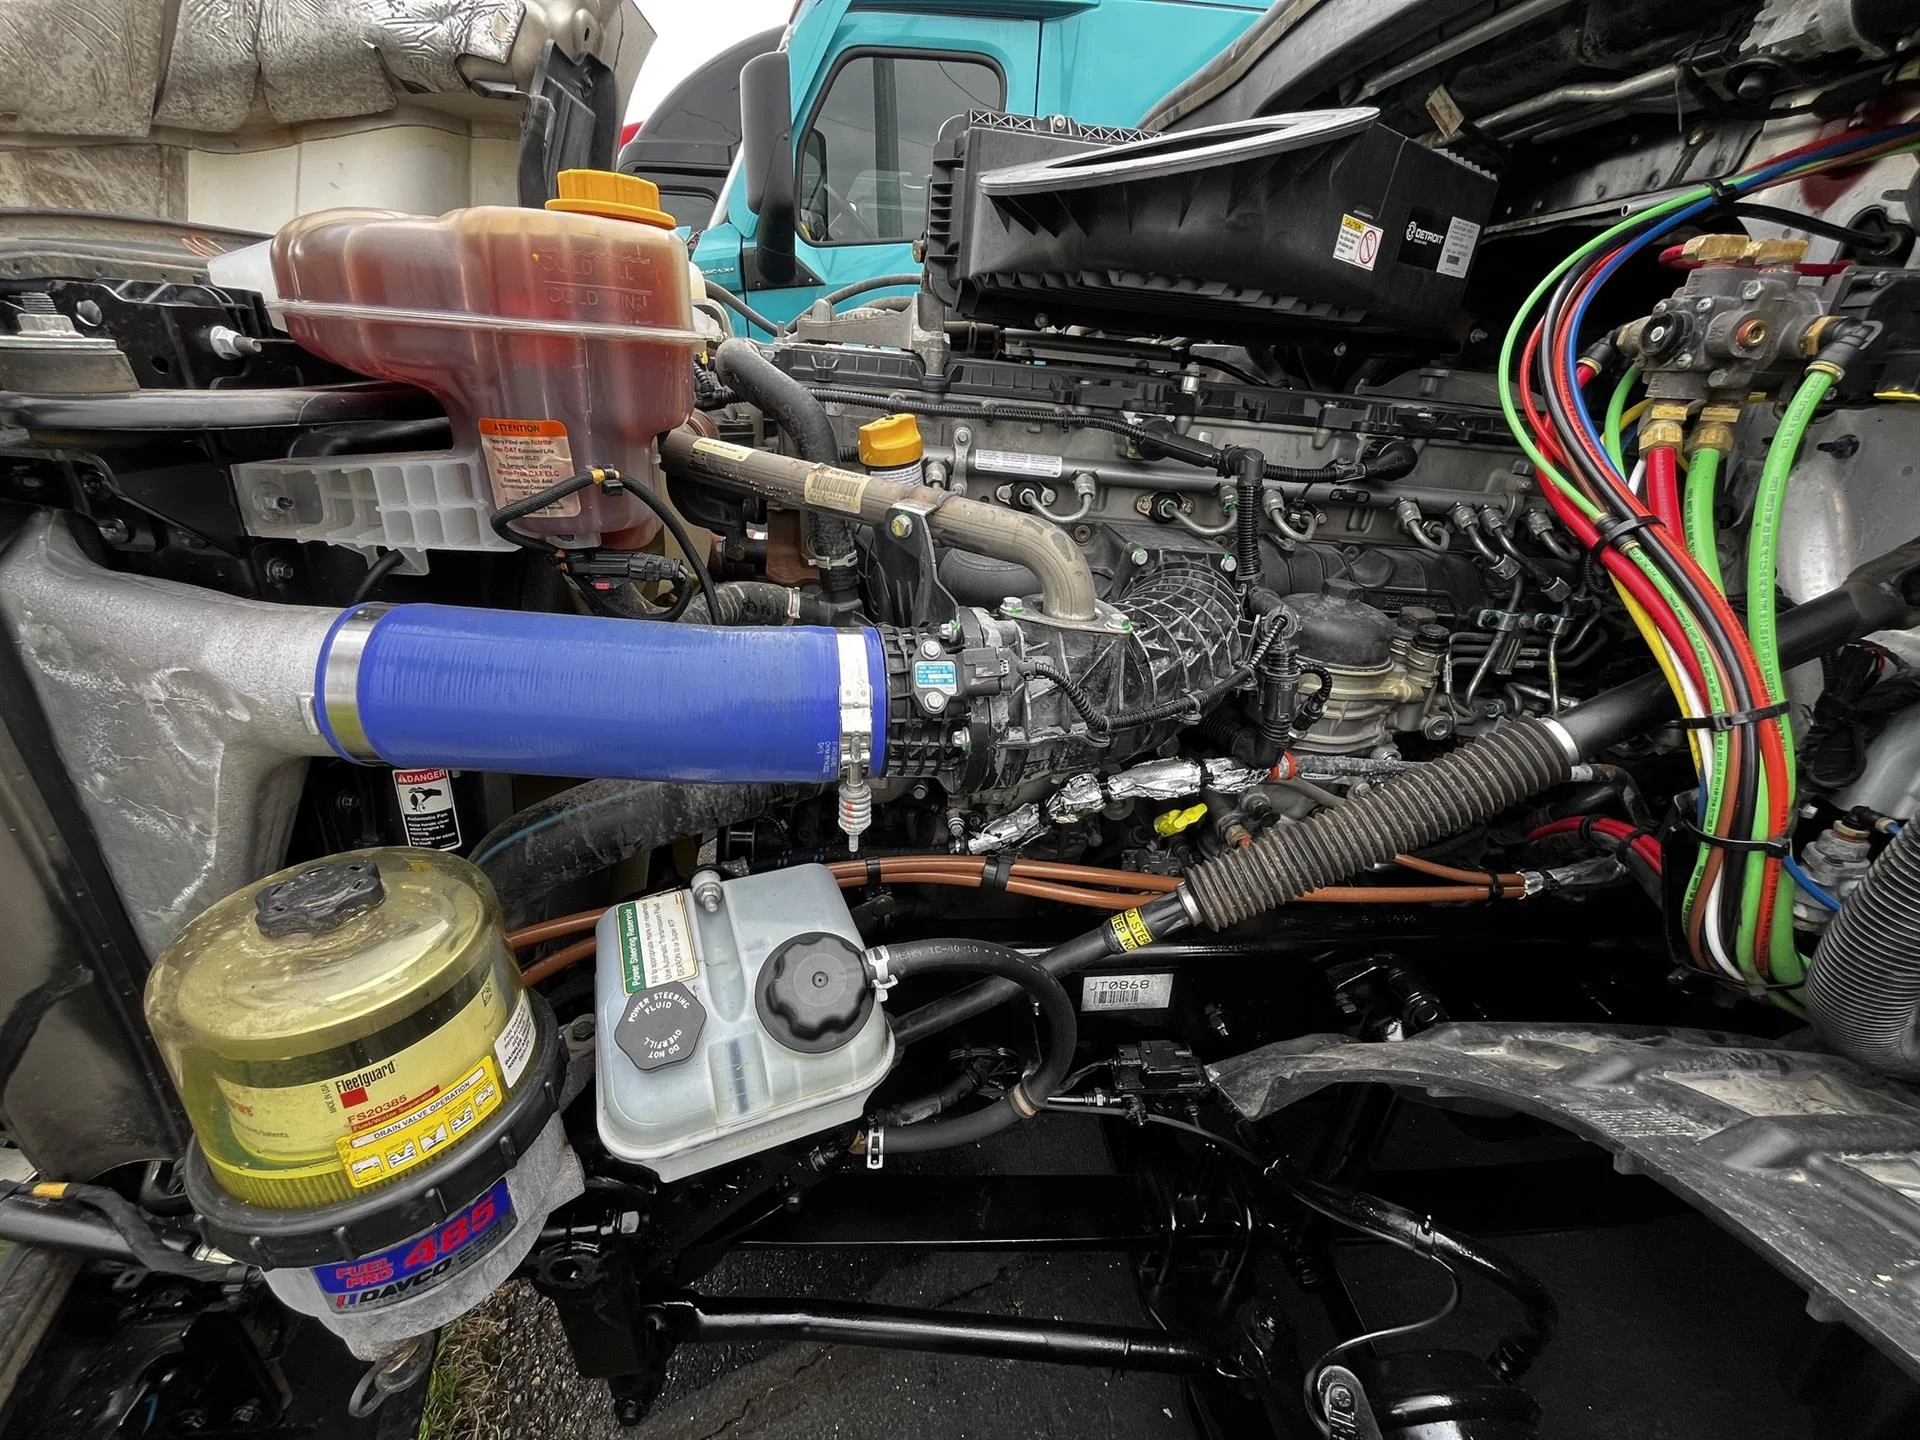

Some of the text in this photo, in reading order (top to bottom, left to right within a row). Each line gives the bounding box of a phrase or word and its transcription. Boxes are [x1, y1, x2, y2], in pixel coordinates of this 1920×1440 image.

[1414, 228, 1444, 245] DETROIT
[494, 424, 541, 433] ATTENTION
[406, 769, 446, 783] DANGER
[655, 914, 666, 944] Transmission
[1130, 921, 1151, 944] STEP
[624, 908, 642, 986] Power Steering Reservoir
[1089, 979, 1151, 991] JT0868
[628, 991, 691, 1023] POWER STEERING
[644, 1001, 673, 1016] FLUID
[643, 1028, 683, 1050] OVERFILL
[648, 1044, 681, 1059] DO NOT
[335, 1060, 396, 1094] Fleetguard
[347, 1094, 408, 1125] FS20385
[352, 1110, 398, 1132] Fuel/Water
[400, 1089, 436, 1113] Separator
[374, 1123, 402, 1139] DRAIN
[401, 1109, 428, 1128] VALVE
[429, 1081, 471, 1112] OPERATION
[403, 1195, 496, 1270] 485
[336, 1256, 394, 1279] FUEL
[346, 1267, 394, 1289] PRO
[359, 1256, 454, 1303] DAYCO
